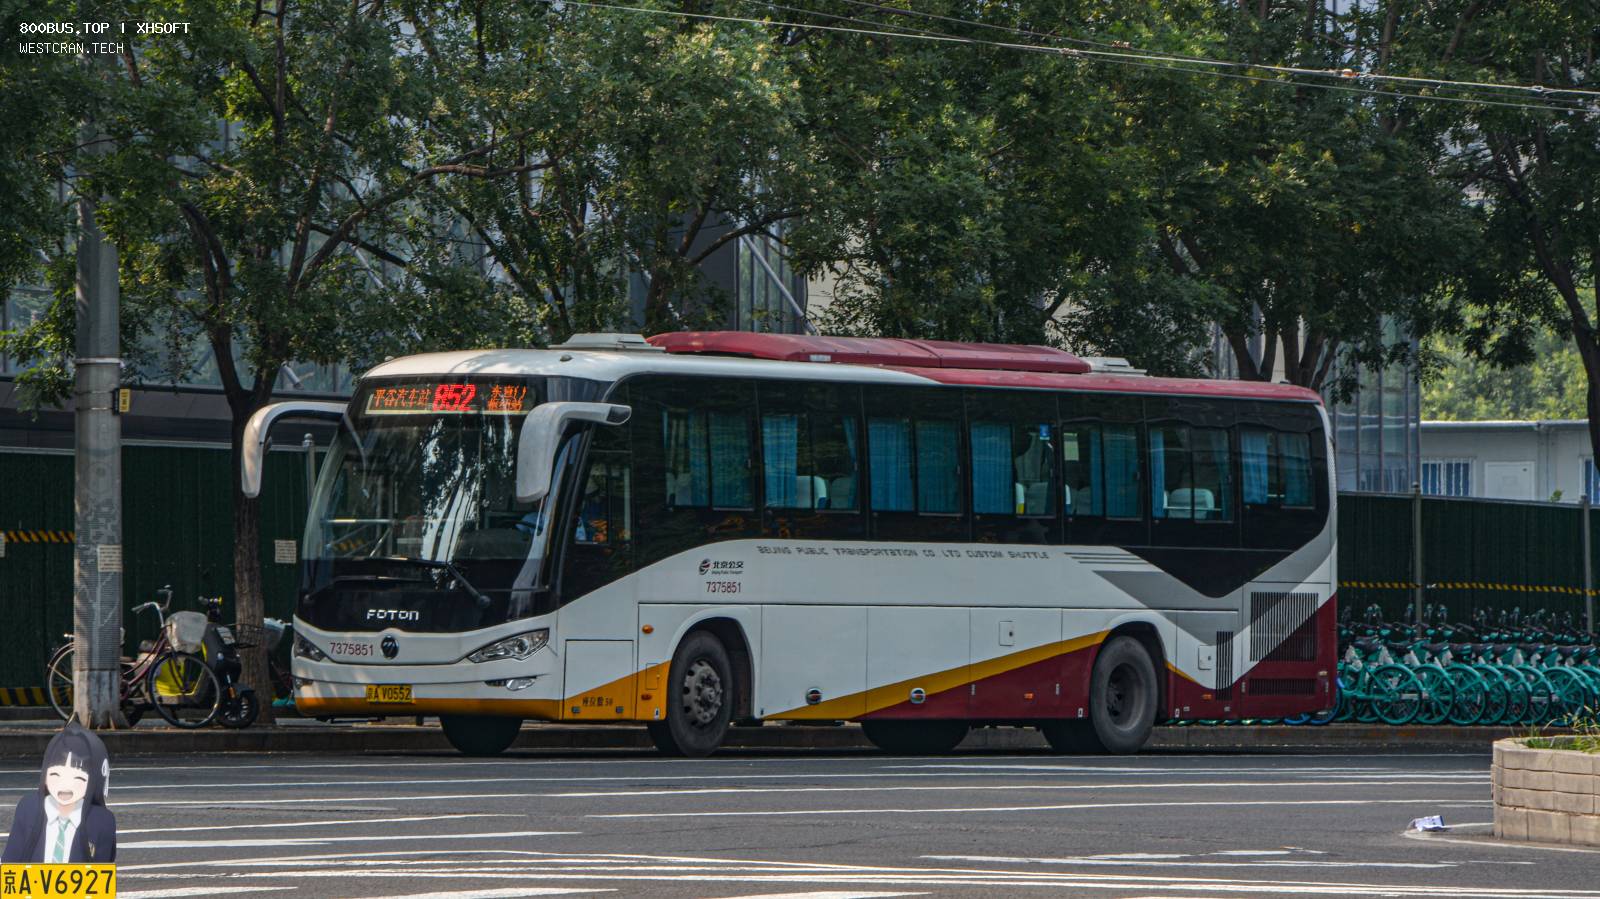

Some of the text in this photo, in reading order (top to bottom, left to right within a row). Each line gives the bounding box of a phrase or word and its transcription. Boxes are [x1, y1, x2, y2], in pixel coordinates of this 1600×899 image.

[374, 388, 432, 408] 平谷汽车站
[432, 384, 477, 412] 852
[795, 547, 829, 555] PUBLIC
[966, 550, 1004, 558] CUSTOM
[1007, 551, 1050, 559] SHUTTLE
[713, 560, 745, 569] 北京公交
[705, 581, 742, 593] 7375851
[366, 609, 420, 621] FOTON
[329, 642, 374, 656] 7375851
